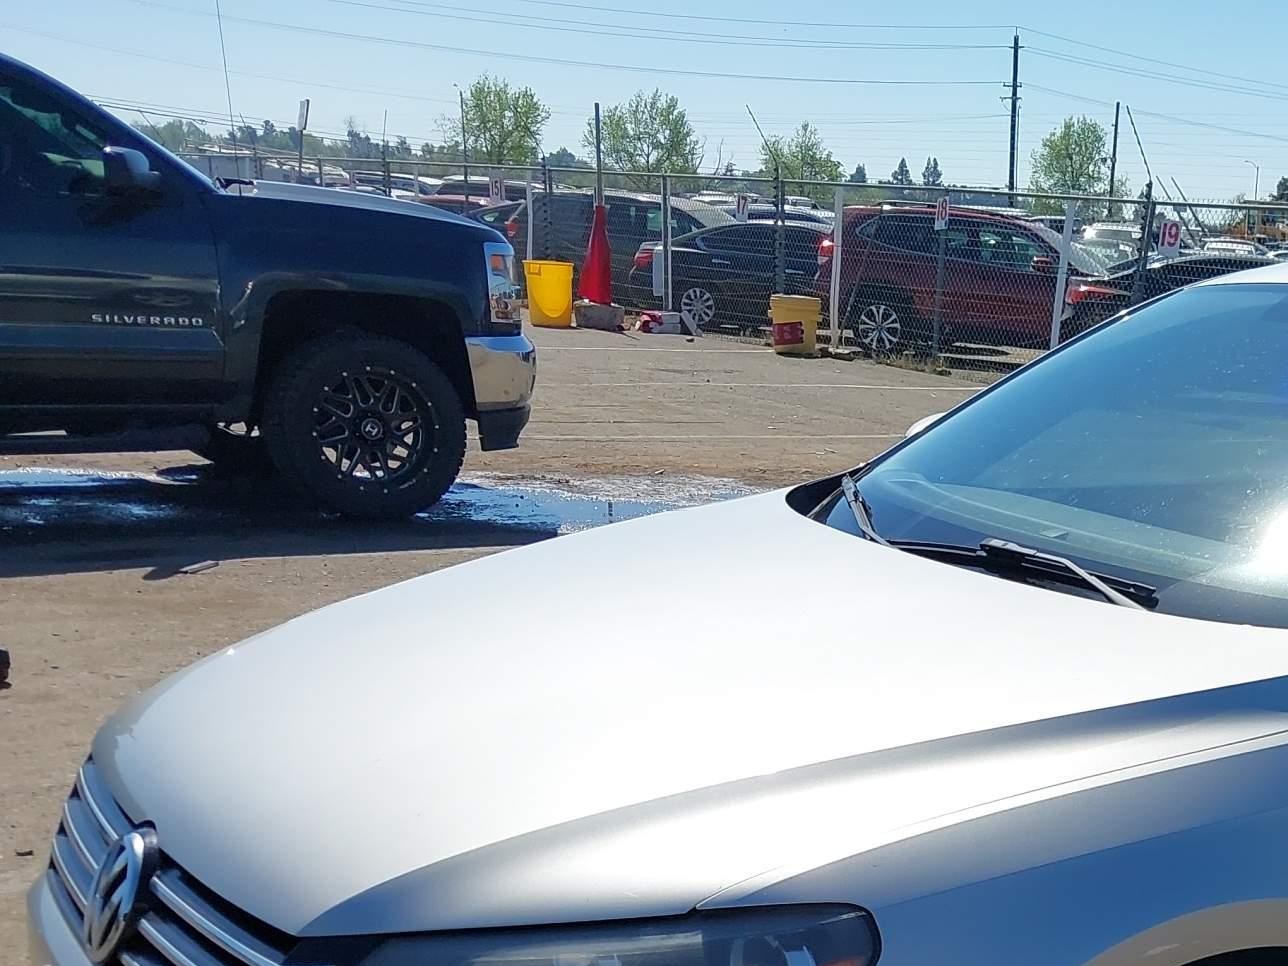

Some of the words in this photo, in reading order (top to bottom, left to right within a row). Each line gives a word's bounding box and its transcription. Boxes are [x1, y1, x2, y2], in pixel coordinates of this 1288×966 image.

[737, 195, 748, 215] 17
[937, 199, 948, 221] 18
[1161, 222, 1180, 247] 19
[91, 313, 203, 326] SILVERADO
